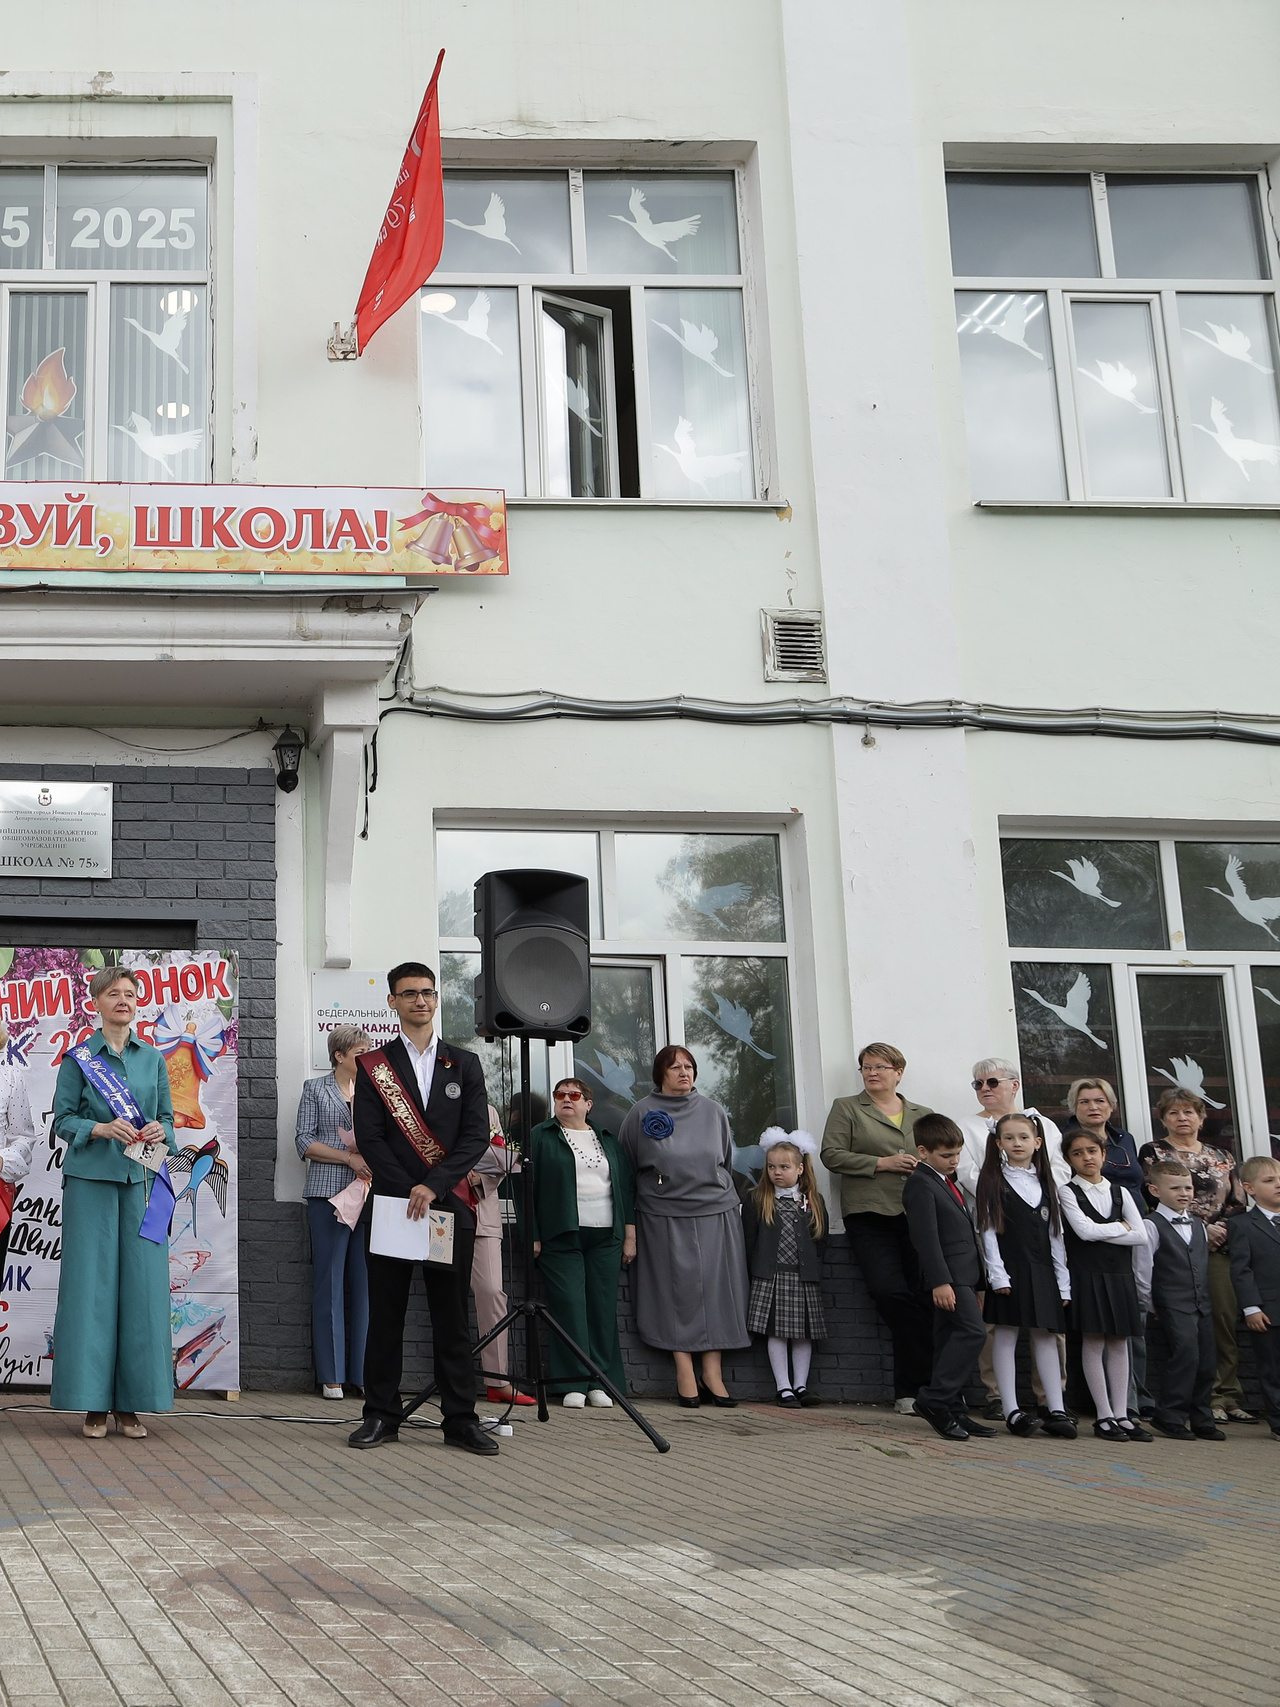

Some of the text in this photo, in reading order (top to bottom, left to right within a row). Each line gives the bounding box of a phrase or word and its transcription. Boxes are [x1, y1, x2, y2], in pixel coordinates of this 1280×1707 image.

[70, 206, 196, 250] 2025
[133, 505, 390, 552] ШКОЛА!
[57, 857, 75, 868] №
[78, 857, 99, 869] 75»
[317, 1008, 388, 1019] ФЕДЕРАЛЬНЫЙ
[362, 1023, 401, 1034] КАЖД
